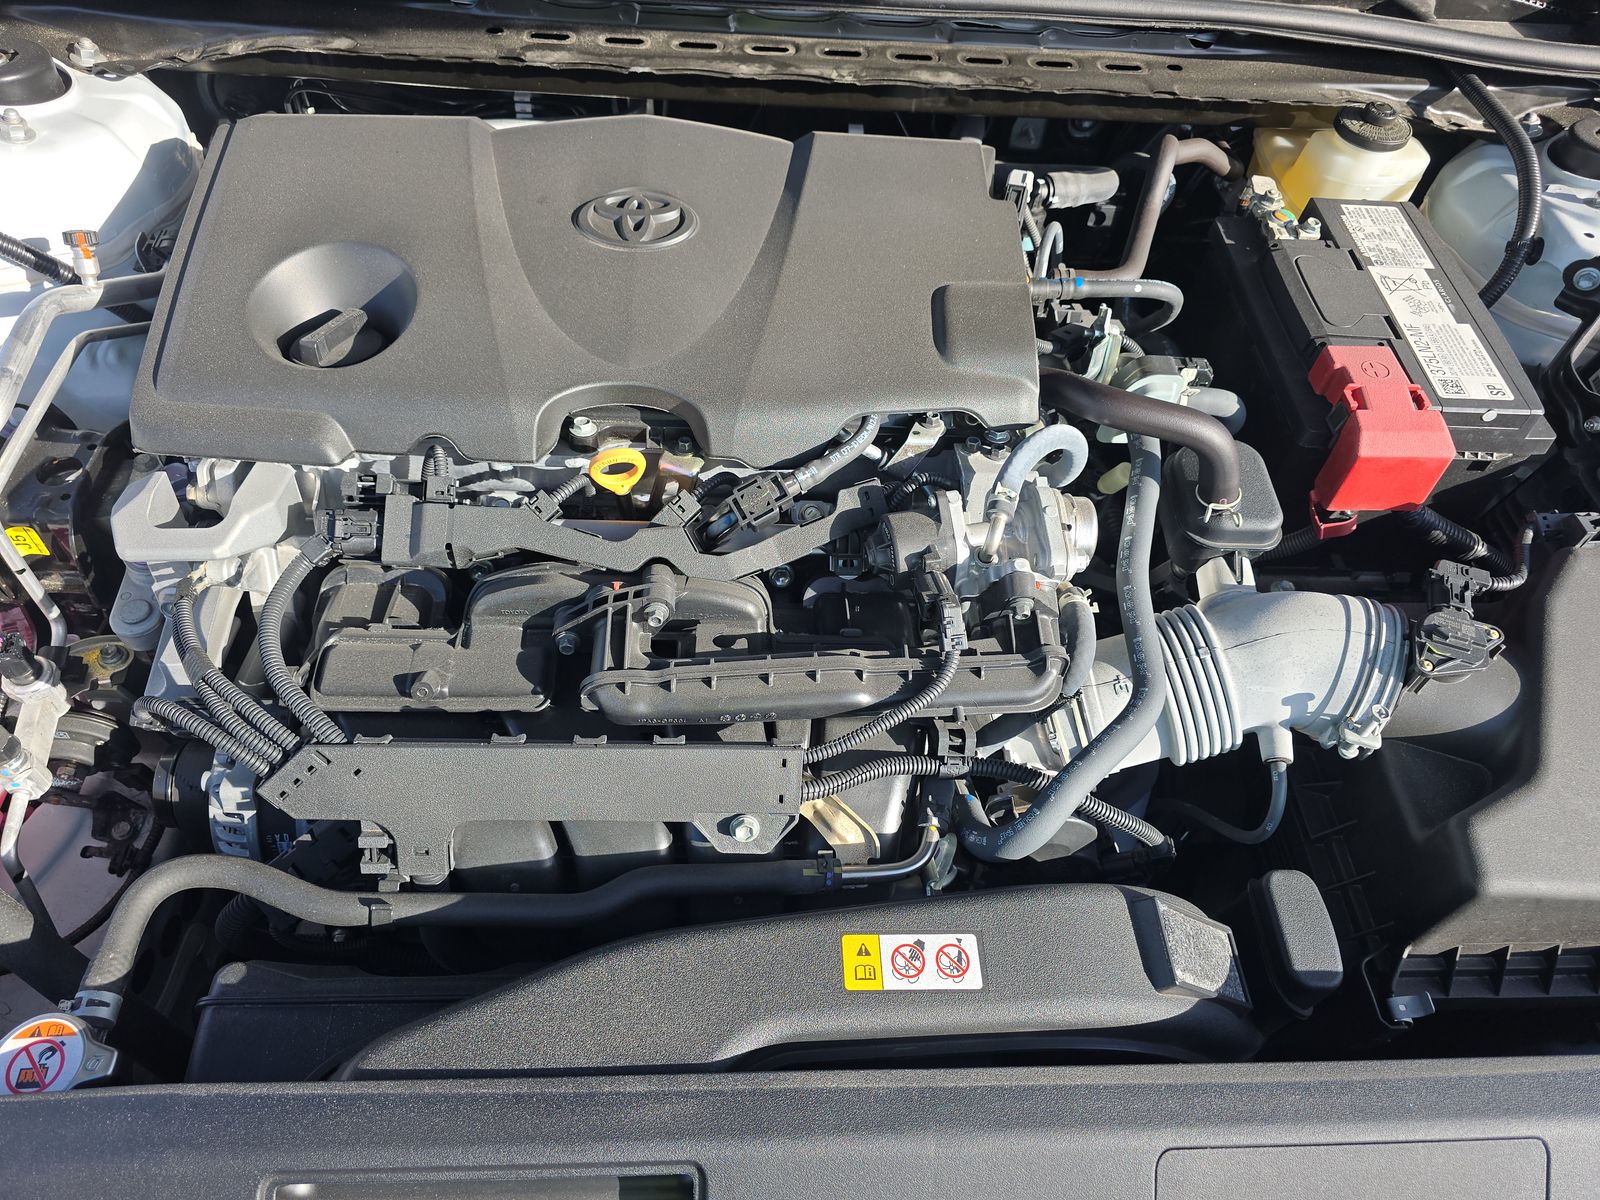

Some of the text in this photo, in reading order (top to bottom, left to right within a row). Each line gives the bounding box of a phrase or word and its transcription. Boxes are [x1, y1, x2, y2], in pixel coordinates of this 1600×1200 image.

[1422, 280, 1432, 290] Pb
[1433, 279, 1452, 304] CLARIOS
[1403, 323, 1446, 376] 375LN2-MF
[1486, 384, 1506, 397] SP
[10, 535, 32, 549] J5
